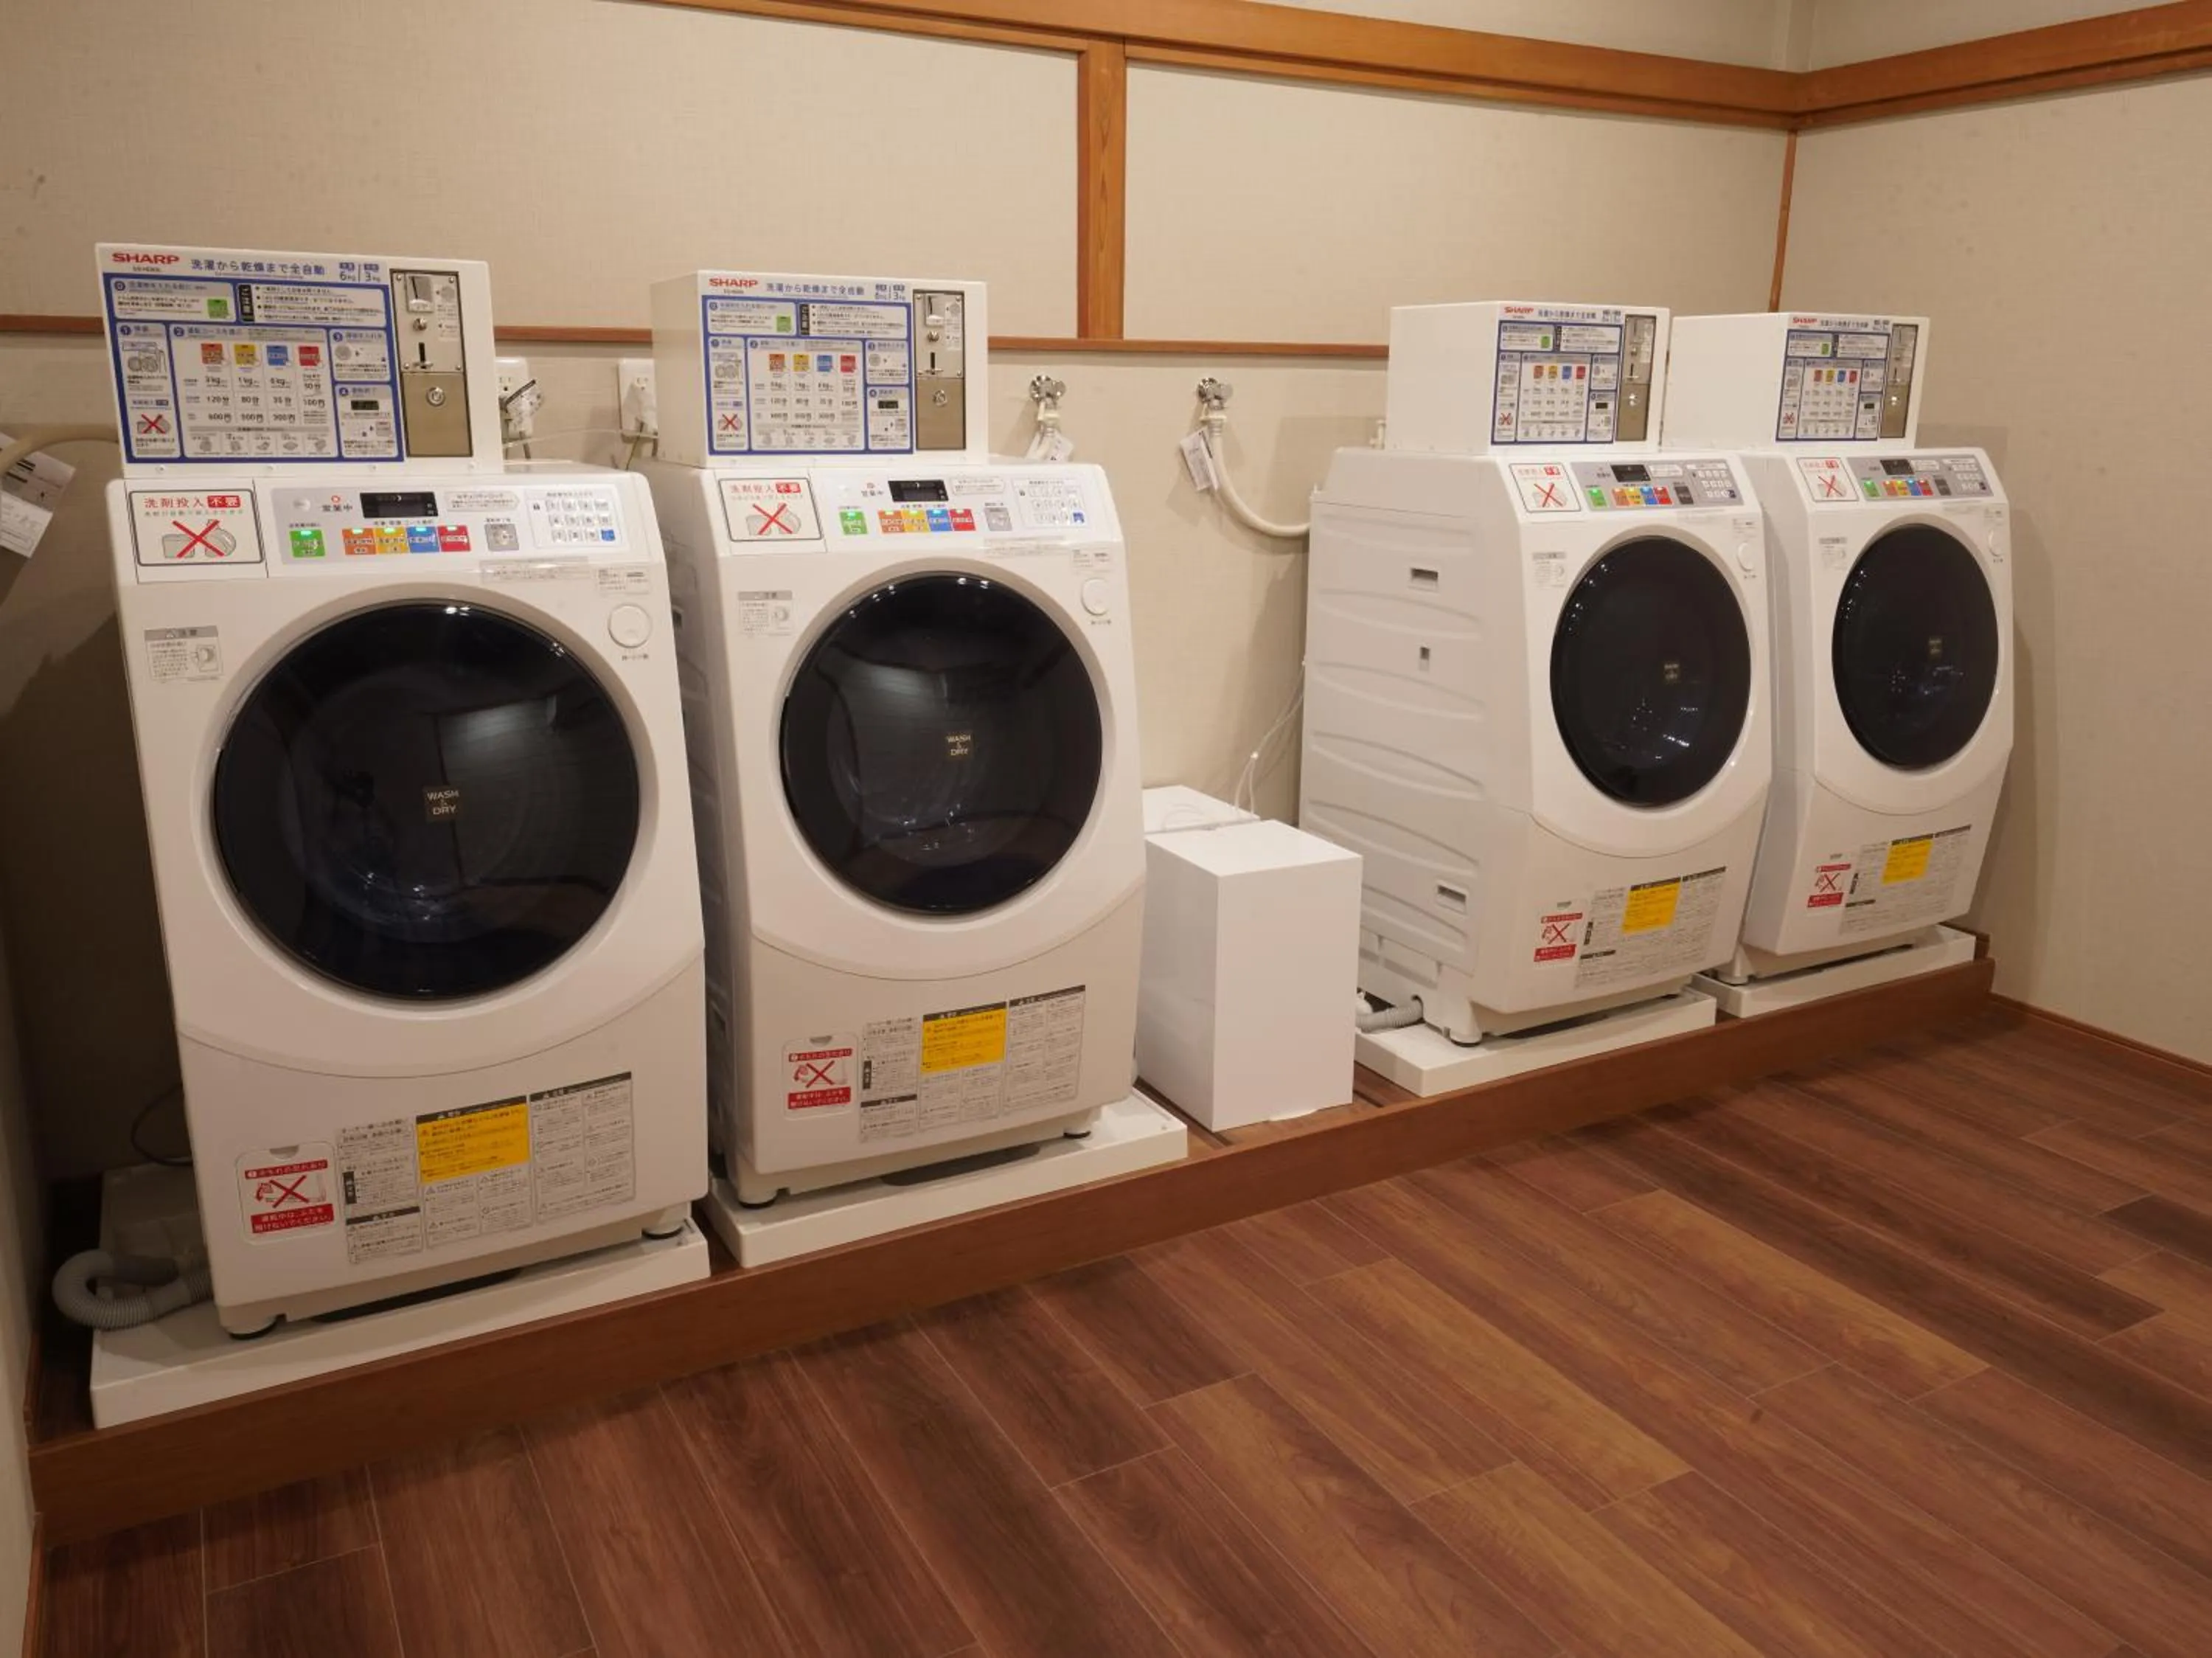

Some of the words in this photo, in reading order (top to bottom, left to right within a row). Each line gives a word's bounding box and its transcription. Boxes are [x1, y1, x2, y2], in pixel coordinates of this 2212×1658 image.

[112, 252, 180, 265] SHARP
[191, 259, 325, 276] 洗濯から乾燥まで全自動
[709, 278, 758, 288] SHARP
[144, 497, 204, 508] 洗剤投入
[427, 790, 459, 800] WASH
[434, 805, 456, 815] DRY
